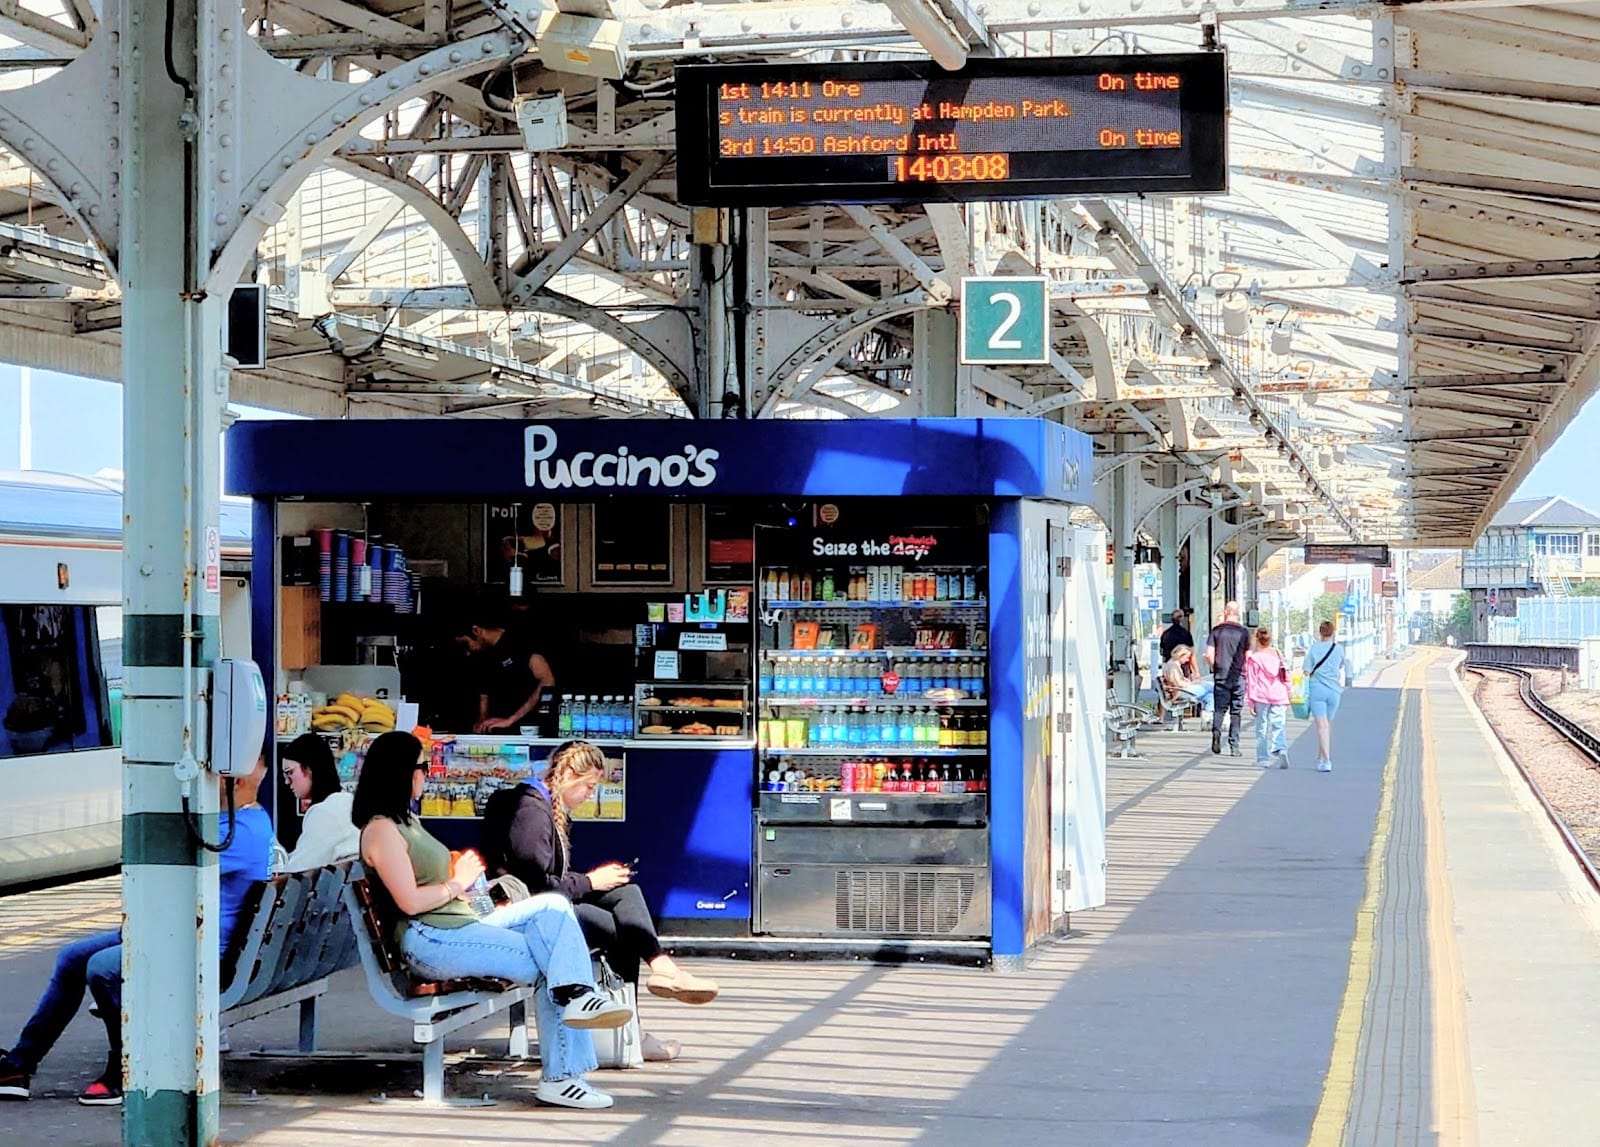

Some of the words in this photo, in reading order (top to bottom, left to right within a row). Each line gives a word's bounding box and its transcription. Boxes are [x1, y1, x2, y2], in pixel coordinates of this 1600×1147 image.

[720, 83, 750, 100] 1st
[760, 82, 812, 98] 14:11
[822, 81, 861, 98] Ore
[1098, 74, 1125, 90] On
[1134, 73, 1180, 89] time
[719, 110, 731, 125] s
[738, 107, 784, 123] train
[789, 106, 806, 122] is
[812, 104, 904, 123] currently
[911, 103, 929, 120] at
[939, 102, 1015, 121] Hampden
[1022, 100, 1070, 117] Park.
[720, 138, 754, 155] 3rd
[761, 137, 815, 153] 14:50
[823, 135, 908, 152] Ashford
[917, 134, 958, 150] Intl
[1099, 130, 1126, 146] On
[1135, 129, 1181, 145] time
[894, 154, 1007, 181] 14:03:08
[988, 292, 1022, 349] 2
[524, 425, 720, 489] Puccino's
[812, 537, 858, 556] Seize
[861, 539, 891, 556] the
